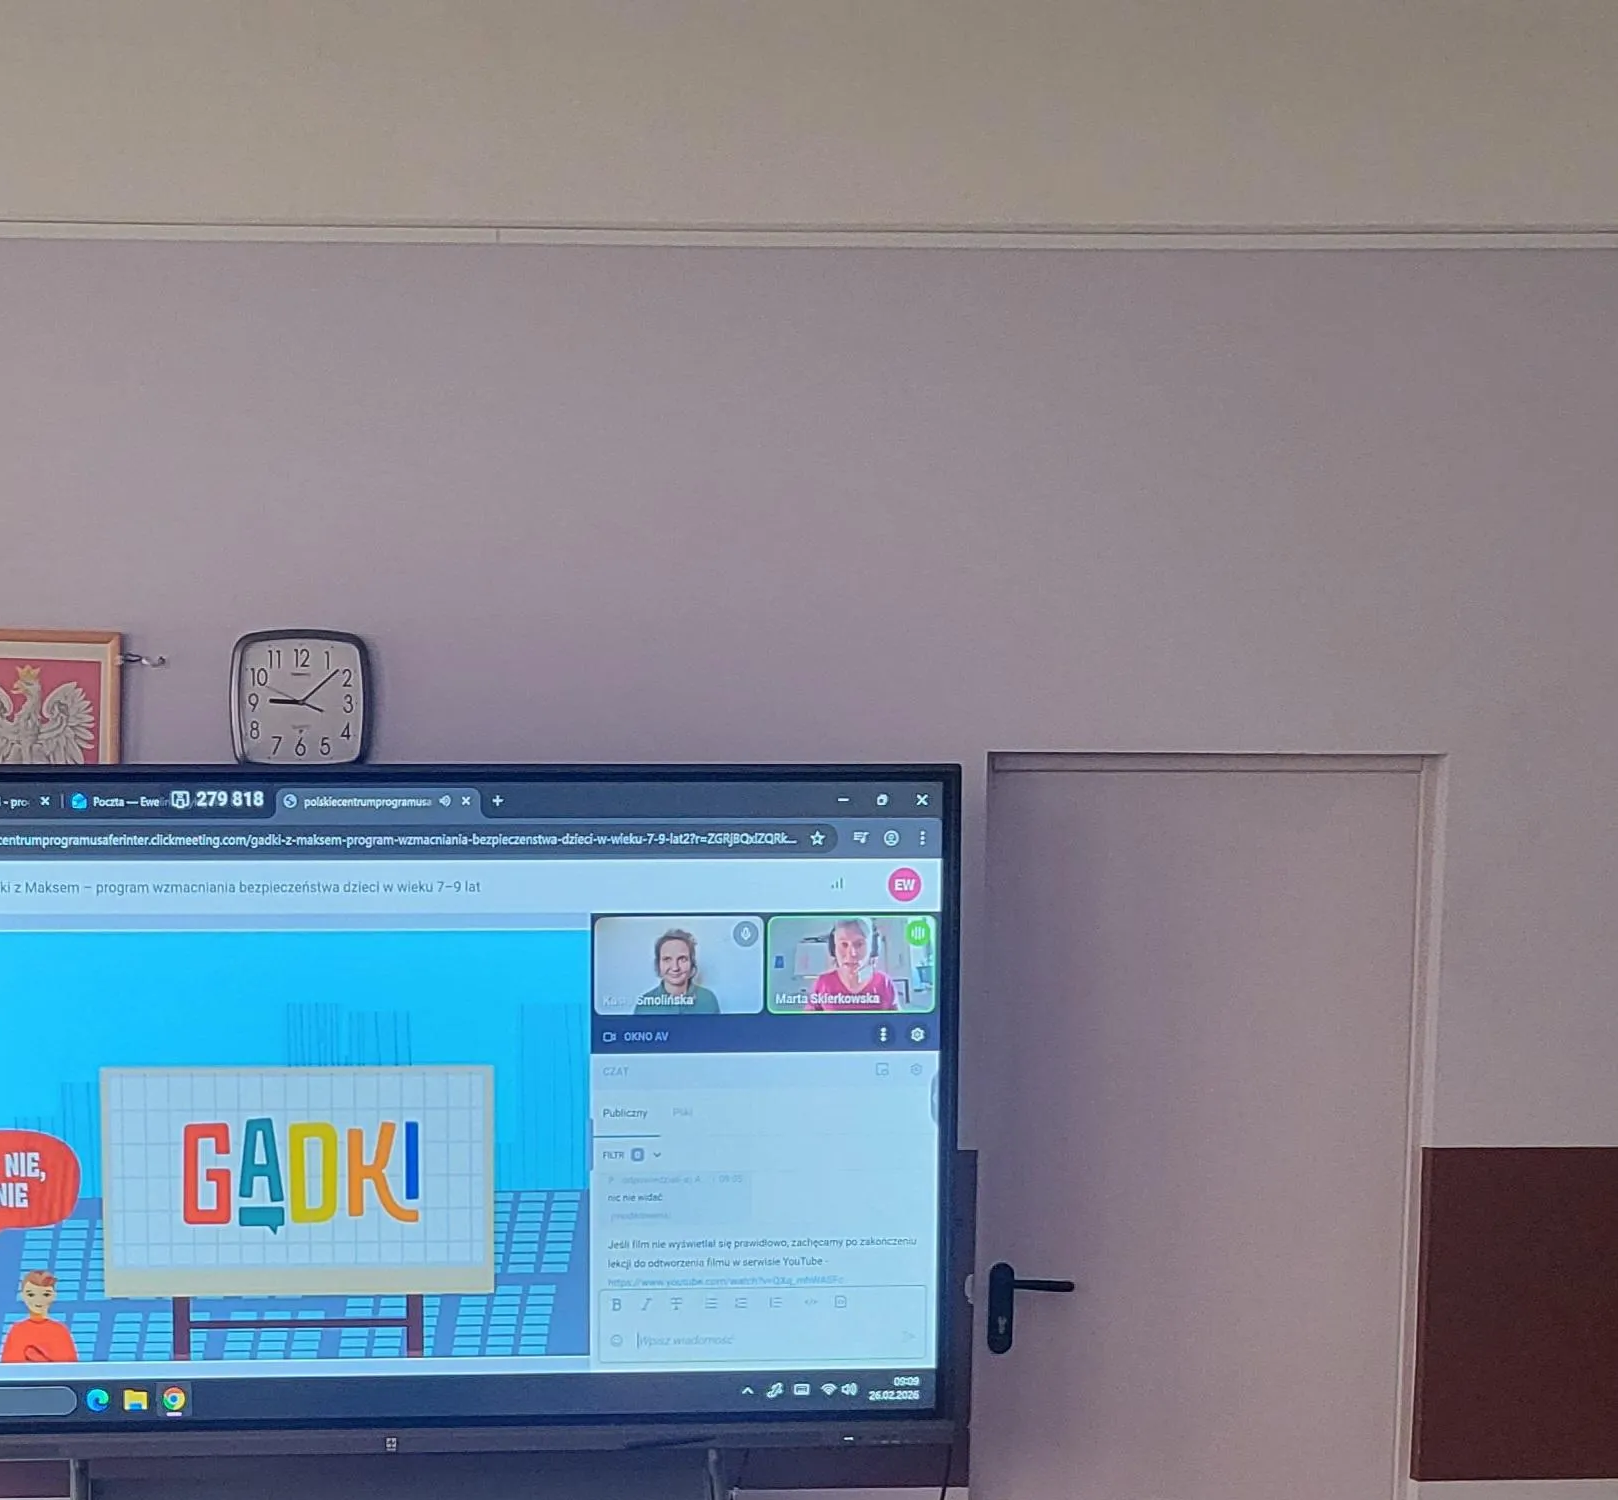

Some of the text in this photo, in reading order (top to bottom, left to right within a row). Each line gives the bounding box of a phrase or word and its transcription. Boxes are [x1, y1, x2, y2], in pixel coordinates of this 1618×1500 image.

[268, 650, 281, 669] 11
[294, 649, 310, 668] 12
[324, 651, 330, 670] 1
[250, 668, 268, 687] 10
[342, 669, 352, 687] 2
[248, 693, 259, 712] 9
[343, 694, 353, 713] 3
[250, 720, 259, 739] 8
[341, 722, 351, 740] 4
[272, 736, 282, 755] 7
[295, 737, 306, 756] 6
[320, 737, 330, 755] 5
[93, 796, 125, 807] Poczta
[197, 790, 264, 807] 279 818
[14, 884, 21, 893] z
[25, 881, 80, 894] Maksem
[96, 883, 149, 896] program
[153, 881, 236, 894] wzmacniania
[239, 881, 340, 895] bezpieczeństwa
[343, 880, 380, 893] dzieci
[382, 884, 393, 893] w
[397, 880, 433, 893] wieku
[465, 880, 481, 893] lat
[894, 879, 916, 891] EW
[637, 993, 695, 1006] Smolińska
[775, 992, 808, 1005] Marta
[624, 1032, 669, 1042] OKNO AV
[603, 1067, 629, 1077] CZAT
[603, 1108, 648, 1119] Publiczny
[602, 1151, 625, 1159] FILTR
[4, 1152, 46, 1182] NIE,
[183, 1117, 420, 1235] GADKI
[622, 1193, 636, 1202] nie
[608, 1239, 631, 1250] Jeśli
[632, 1239, 649, 1249] film
[651, 1239, 667, 1249] nie
[718, 1238, 732, 1250] się
[846, 1239, 858, 1248] po
[608, 1258, 631, 1270] lekcji
[634, 1258, 646, 1268] do
[648, 1258, 704, 1269] odtworzenia
[706, 1257, 730, 1268] filmu
[732, 1259, 741, 1267] w
[743, 1257, 781, 1268] serwisie
[783, 1256, 823, 1267] YouTube
